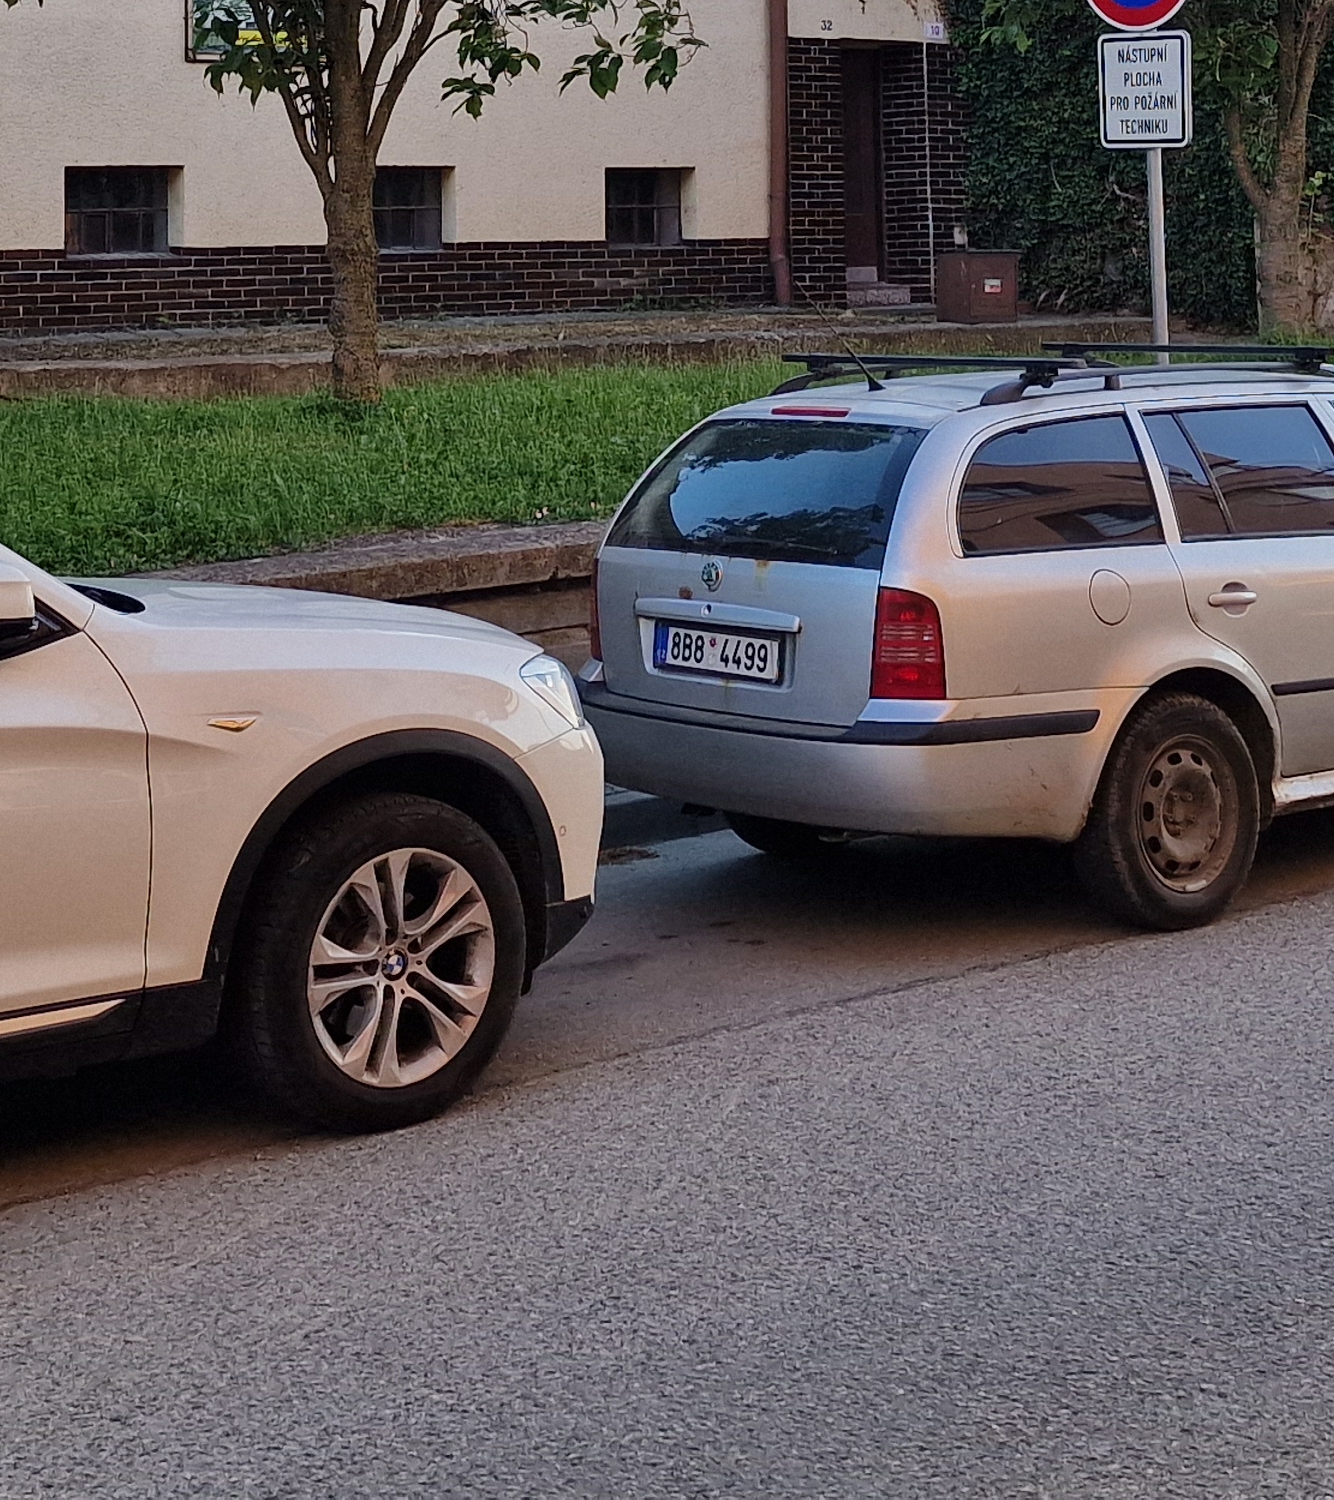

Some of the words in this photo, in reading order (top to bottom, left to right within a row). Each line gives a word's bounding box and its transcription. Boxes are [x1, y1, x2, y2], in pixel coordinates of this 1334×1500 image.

[820, 20, 833, 31] 32
[930, 25, 940, 36] 10
[1117, 43, 1167, 63] NÁSTUPNÍ
[1123, 71, 1163, 87] PLOCHA
[1110, 96, 1130, 111] PRO
[1134, 90, 1178, 110] POŽÁRNÍ
[1119, 119, 1168, 135] TECHNIKU
[671, 631, 705, 663] 8B8
[720, 638, 768, 673] 4499
